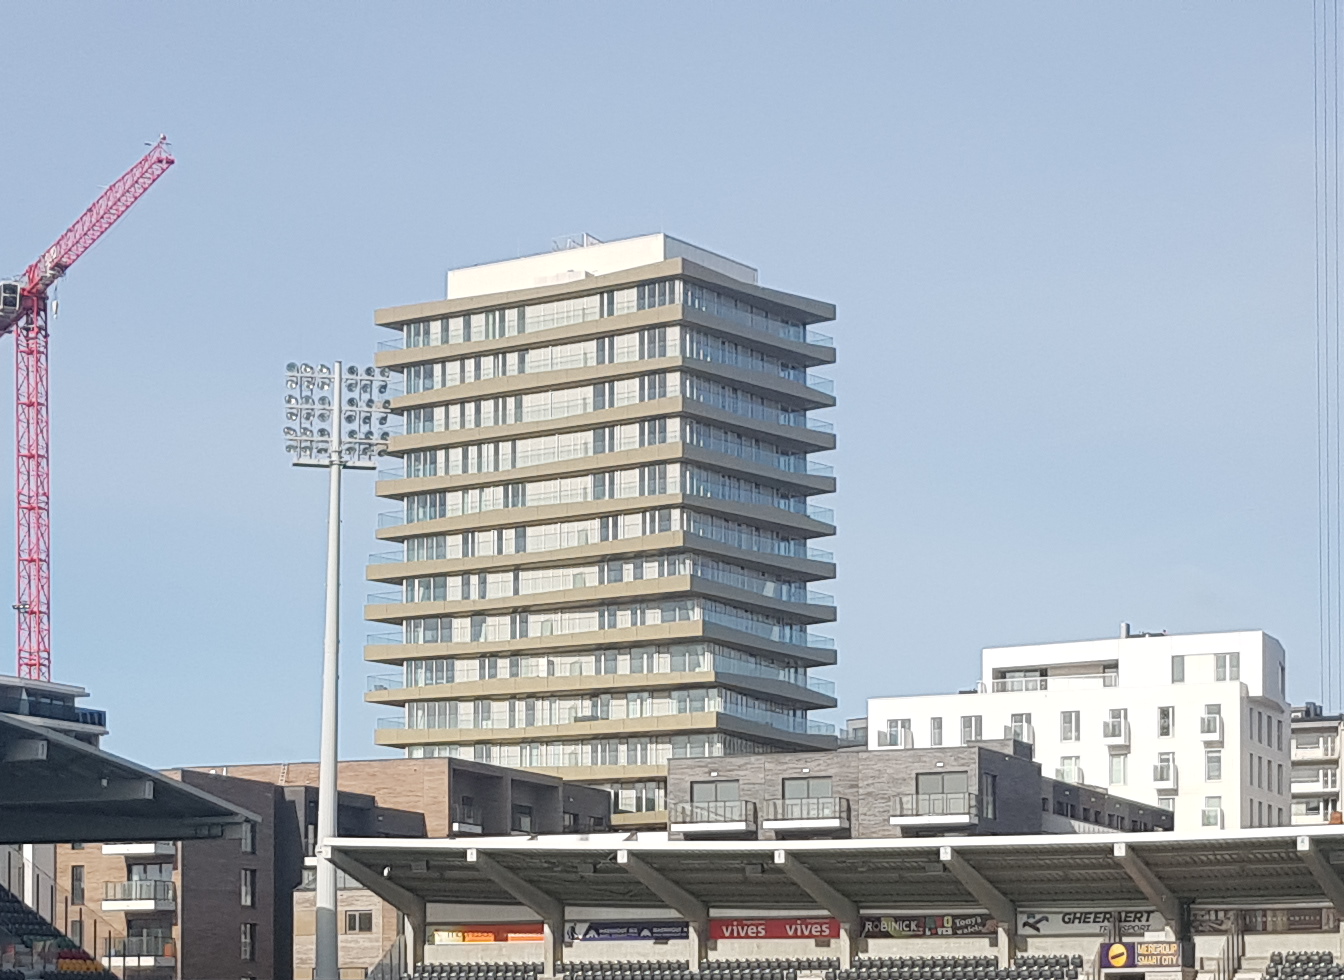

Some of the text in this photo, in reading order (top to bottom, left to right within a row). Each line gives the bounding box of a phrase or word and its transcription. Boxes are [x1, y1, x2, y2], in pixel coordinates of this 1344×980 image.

[721, 921, 766, 937] vives
[785, 920, 830, 936] vives
[864, 920, 918, 932] ROBINICK
[1099, 924, 1151, 933] TRSPORT
[1137, 955, 1177, 966] SMART CITY
